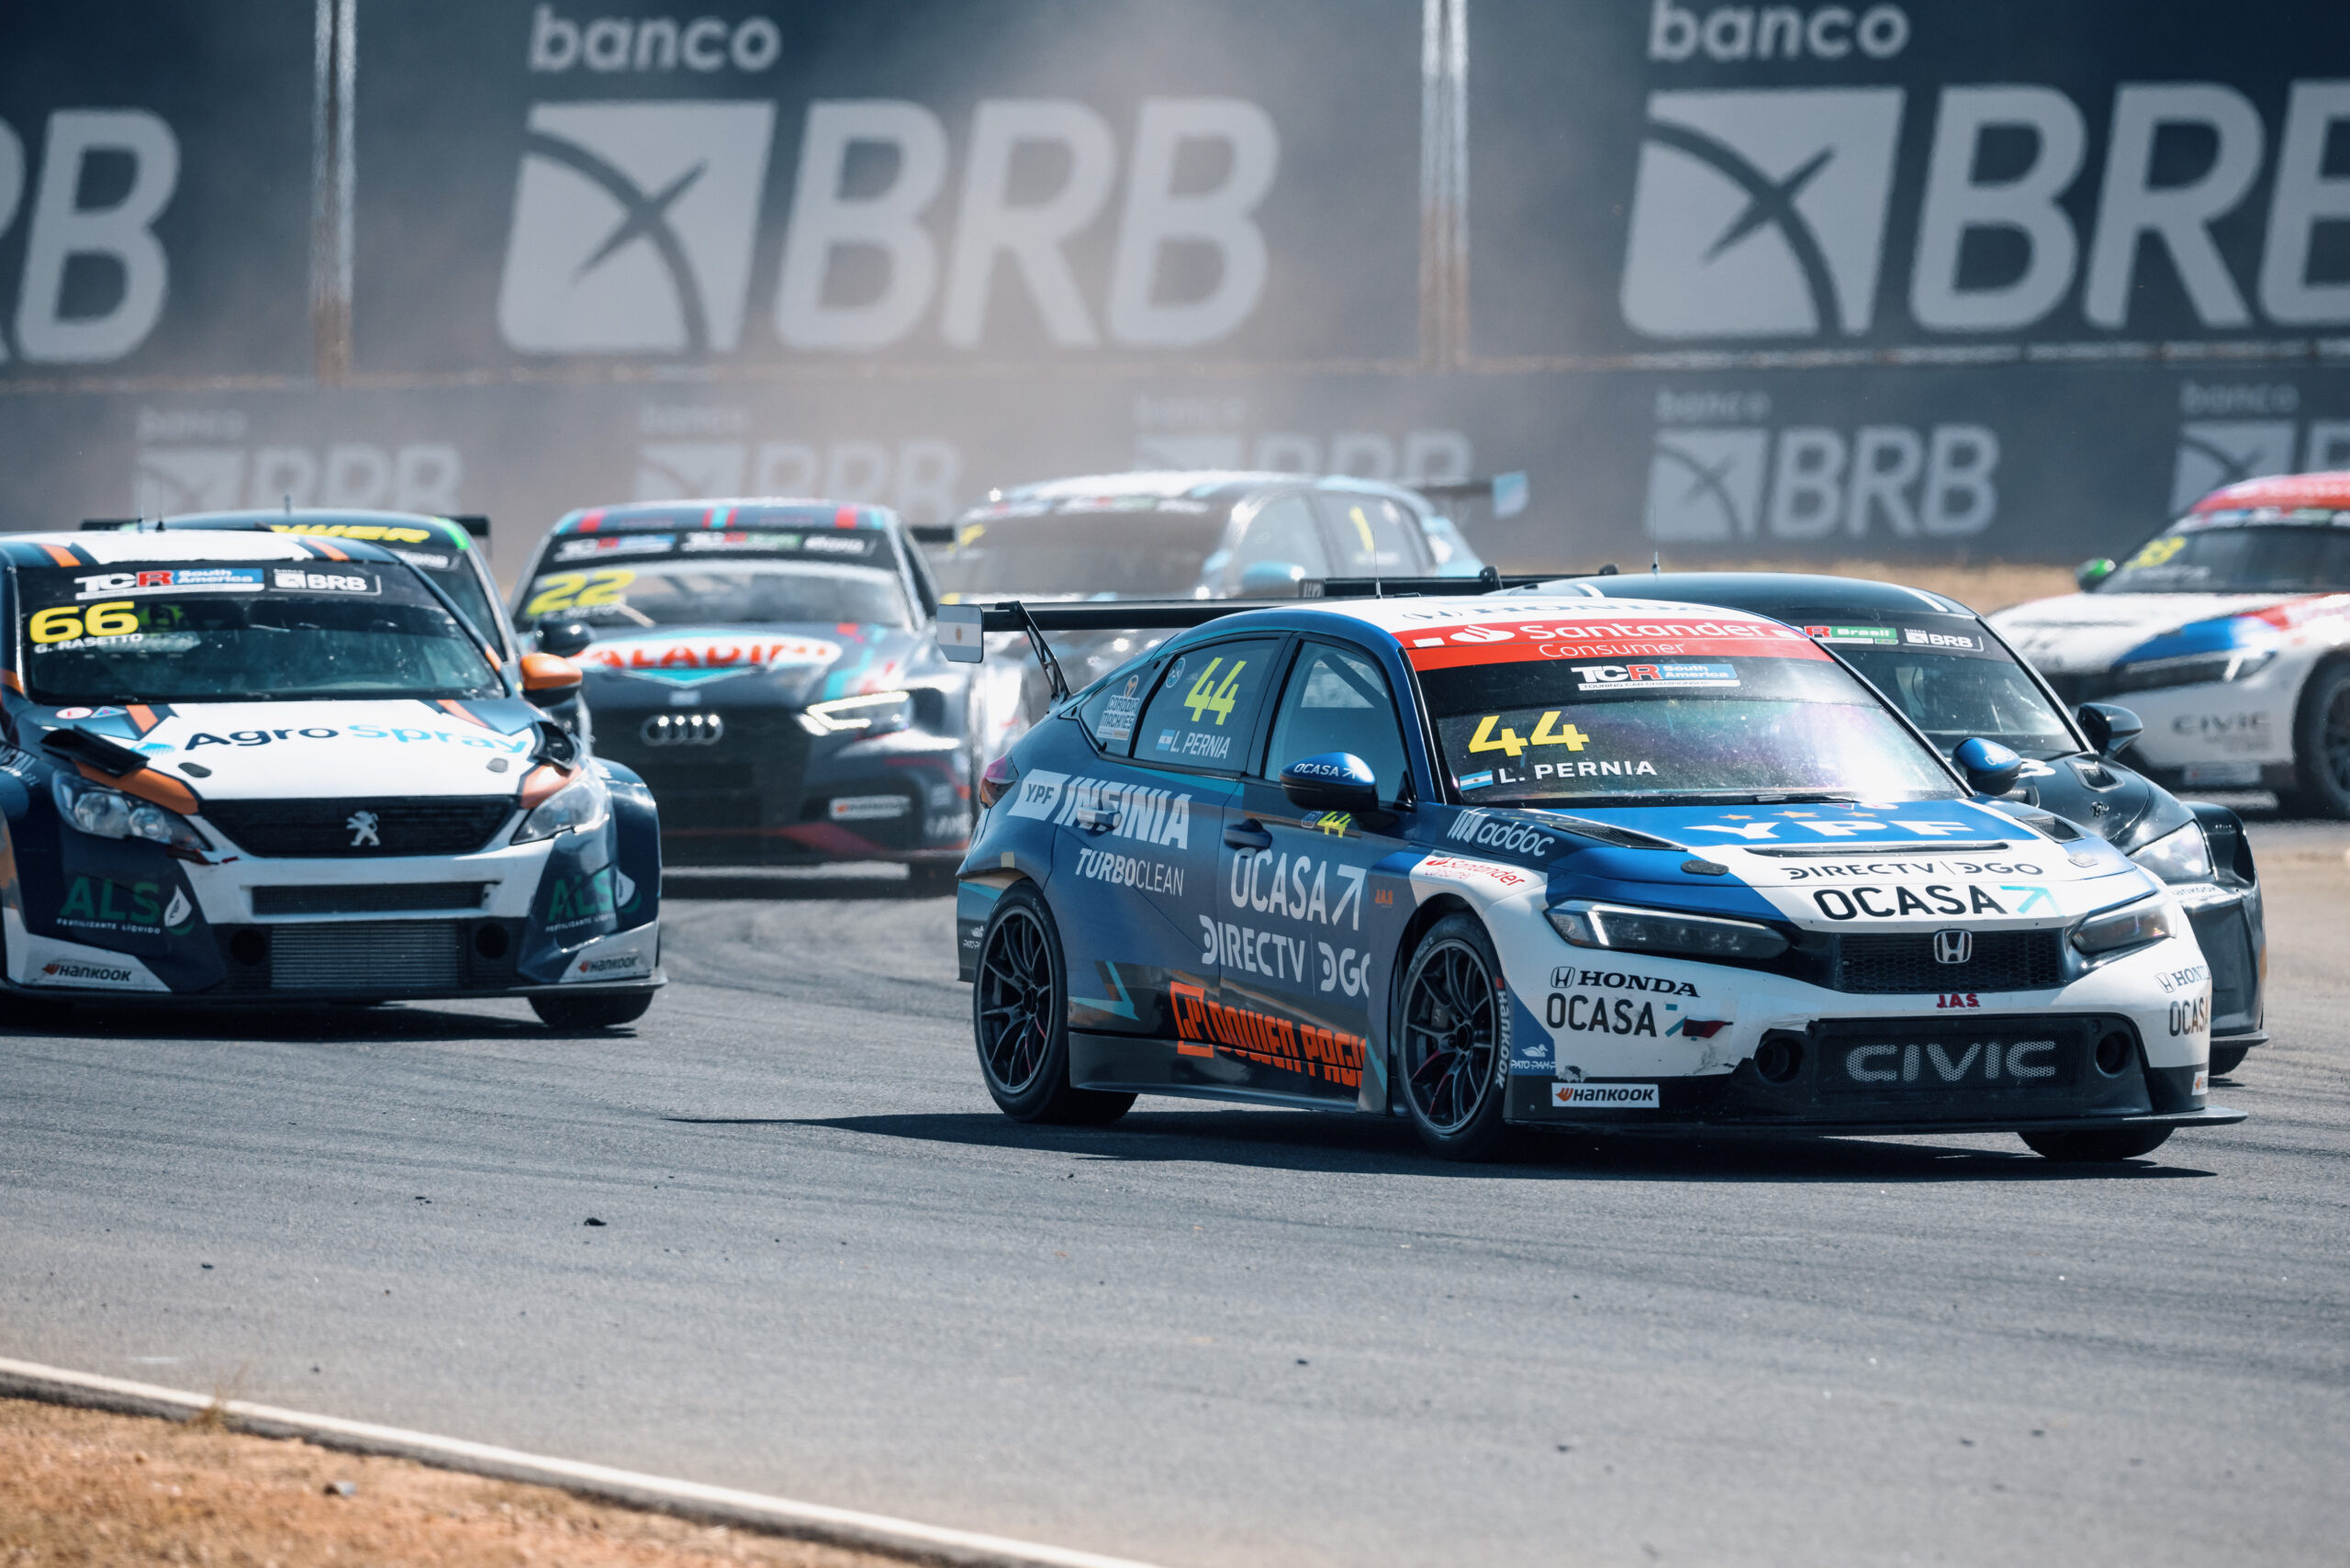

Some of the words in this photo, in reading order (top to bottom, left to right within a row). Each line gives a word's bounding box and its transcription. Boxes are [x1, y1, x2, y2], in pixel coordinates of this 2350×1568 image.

[528, 7, 782, 72] banco
[1649, 2, 1910, 61] banco
[1908, 79, 2350, 333] BRB
[0, 107, 181, 363] B
[775, 96, 1280, 352] BRB
[1770, 423, 2000, 542] BRB
[73, 570, 174, 592] TCR
[177, 569, 233, 578] South
[177, 577, 254, 585] America
[306, 573, 368, 592] BRB
[526, 568, 637, 616] 22
[29, 600, 140, 644] 66
[1520, 620, 1766, 641] Santander
[57, 633, 144, 651] RASETTO
[1539, 642, 1686, 659] Consumer
[1928, 633, 1974, 648] BRB
[1571, 664, 1662, 683] TCR
[1184, 657, 1248, 725] 44
[1469, 711, 1590, 757] 44
[2172, 711, 2271, 734] CIVIC
[185, 728, 340, 751] Agro
[347, 724, 527, 754] Spray
[1170, 731, 1180, 753] L.
[1182, 732, 1231, 759] PERNIA
[1293, 763, 1339, 778] OCASA
[1499, 767, 1526, 784] L.
[1534, 760, 1658, 780] PERNIA
[1024, 783, 1055, 805] YPF
[1053, 776, 1192, 850] INFINIA
[1316, 811, 1352, 838] 44
[1683, 820, 1975, 840] YPF
[1075, 847, 1184, 897] TURBOCLEAN
[1443, 856, 1527, 887] Santander
[1779, 862, 1934, 880] DIRECTV
[1954, 861, 2044, 876] DGO
[59, 876, 161, 924] ALS
[548, 868, 615, 922] ALS
[1231, 848, 1328, 925] OCASA
[1812, 884, 2008, 921] OCASA
[56, 917, 118, 930] FERTILIZANTE
[1199, 914, 1306, 983] DIRECTV
[58, 964, 131, 982] Hankook
[1577, 970, 1701, 999] HONDA
[1546, 992, 1658, 1038] OCASA
[1494, 990, 1510, 1090] Hankook
[1846, 1040, 2056, 1082] CIVIC
[1572, 1088, 1656, 1103] Hankook
